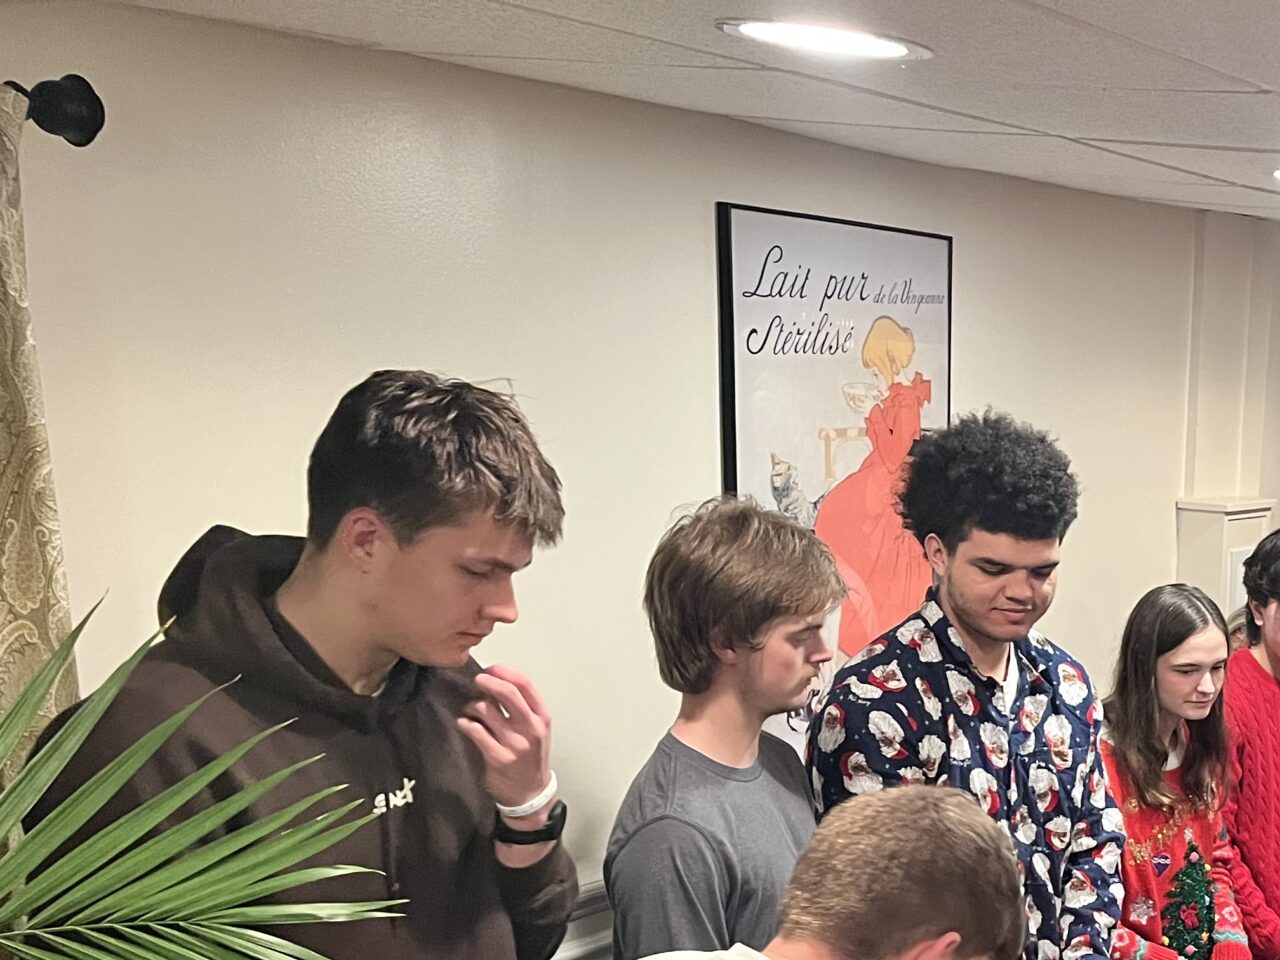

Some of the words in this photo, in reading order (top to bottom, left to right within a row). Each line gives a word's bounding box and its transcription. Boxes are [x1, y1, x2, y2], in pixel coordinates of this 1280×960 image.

[742, 245, 811, 299] Lait
[819, 272, 870, 312] pur
[873, 284, 886, 304] de
[887, 281, 899, 304] la
[746, 313, 854, 355] Stérilisé
